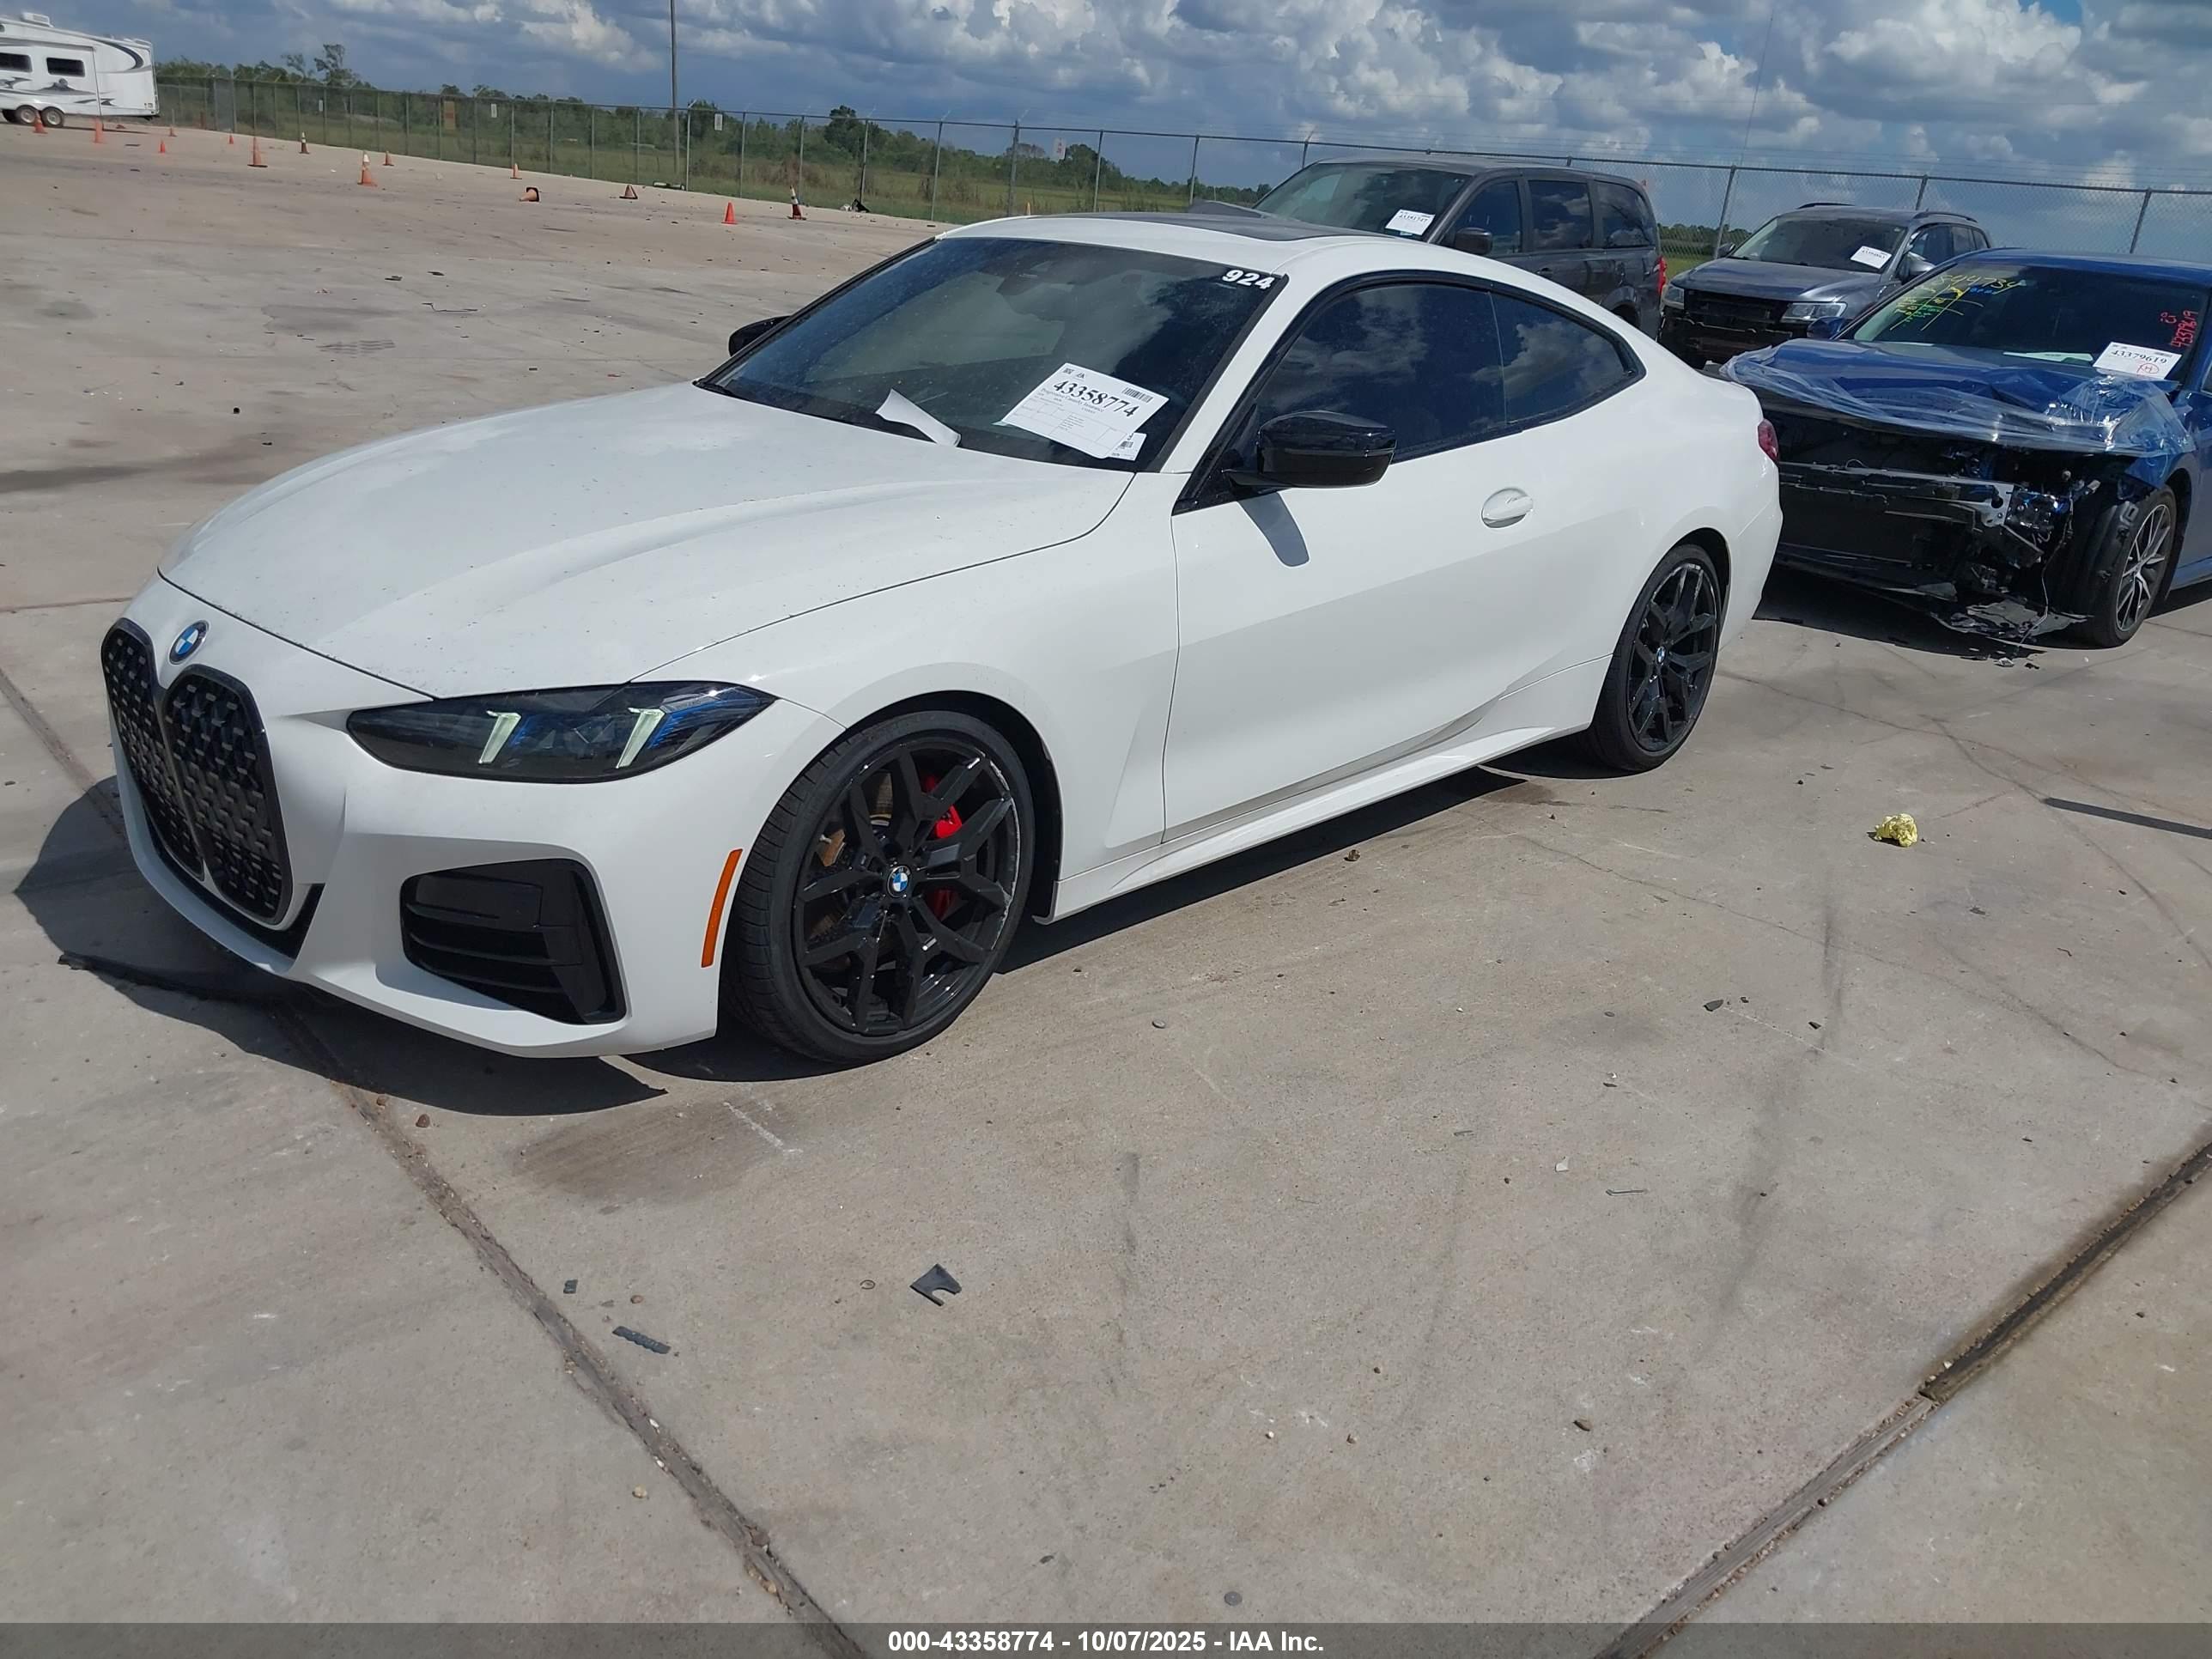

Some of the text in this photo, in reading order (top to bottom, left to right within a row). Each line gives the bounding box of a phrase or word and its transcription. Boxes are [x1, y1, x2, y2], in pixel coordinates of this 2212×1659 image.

[1222, 269, 1275, 289] 924
[2111, 349, 2168, 364] 43379619
[1054, 380, 1140, 417] 43358774
